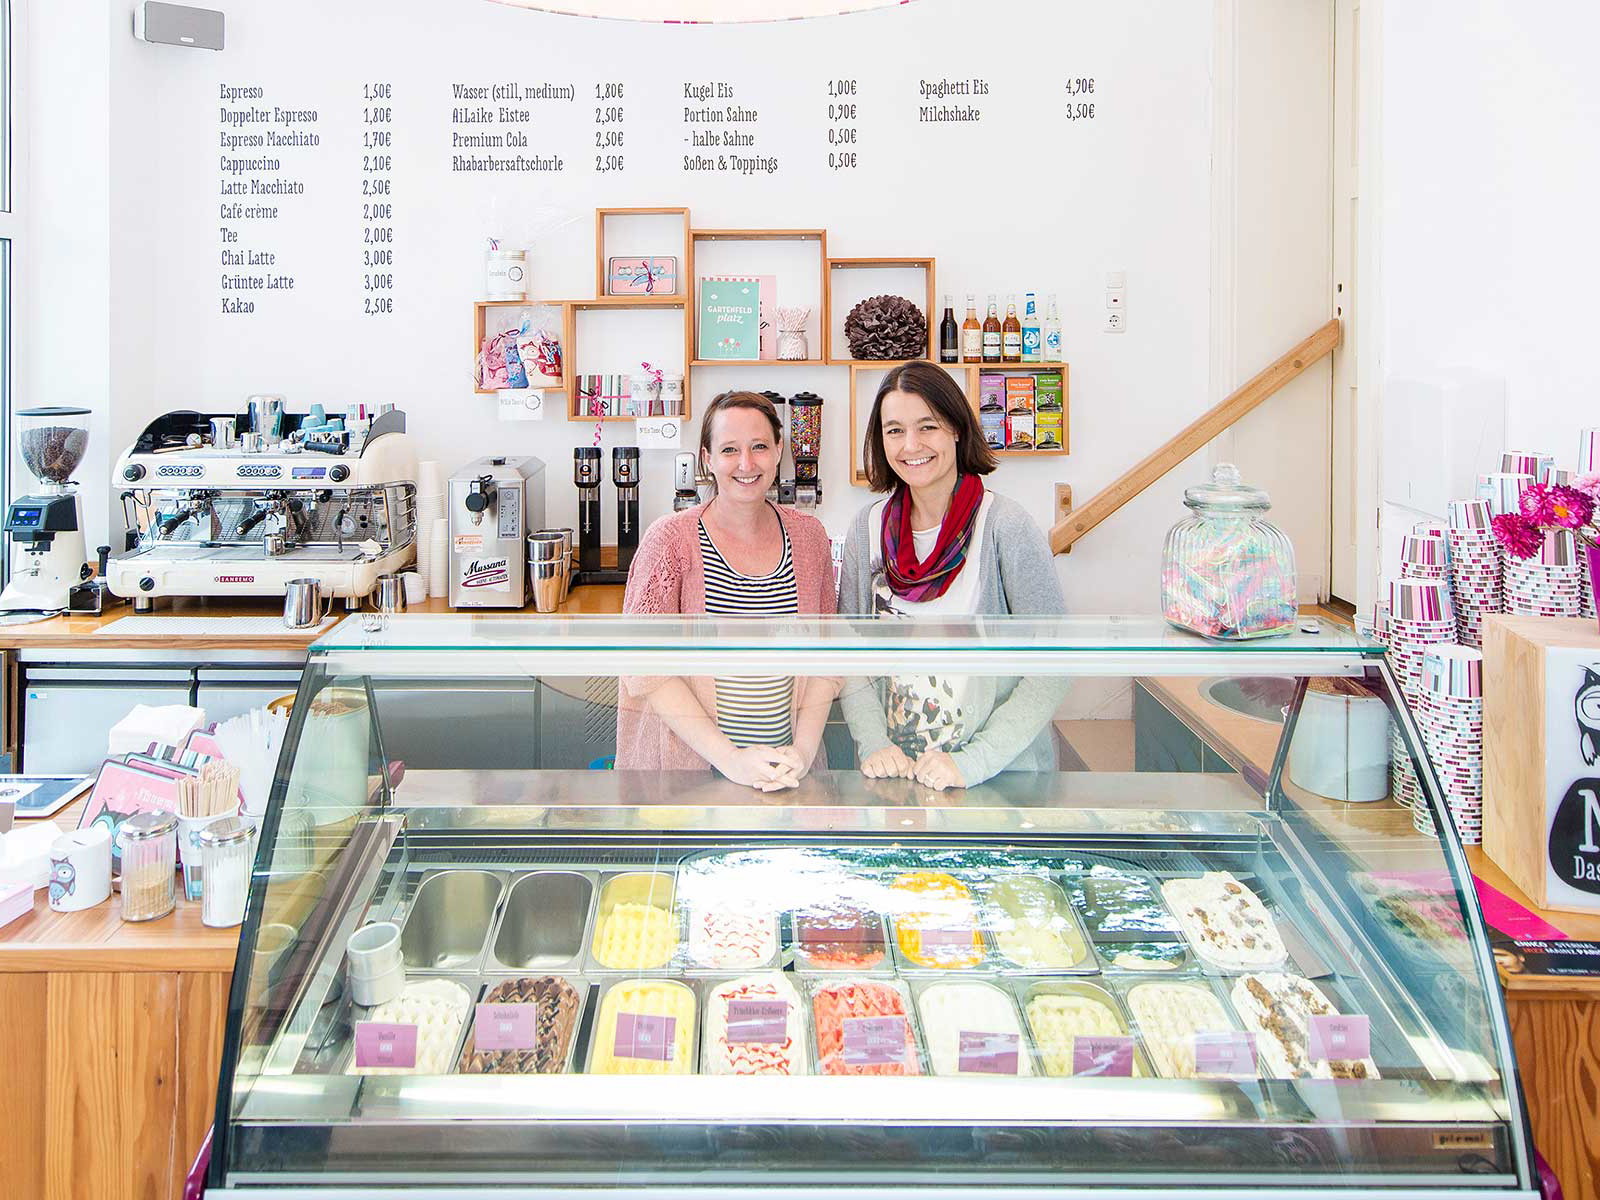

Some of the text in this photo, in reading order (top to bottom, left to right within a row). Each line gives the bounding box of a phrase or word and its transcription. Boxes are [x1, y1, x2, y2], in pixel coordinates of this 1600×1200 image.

[220, 84, 391, 103] Espresso 1,50€
[452, 83, 623, 102] Wasser (still, medium) 1,80€
[684, 80, 856, 102] Kugel Eis 1,00€
[920, 78, 1094, 99] Spaghetti Eis 4,90€
[221, 107, 391, 127] Doppelter Espresso 1,80€
[499, 107, 529, 122] Eistee
[596, 107, 623, 125] 2,50€
[684, 104, 856, 122] Portion Sahne 0,90€
[920, 104, 1095, 122] Milchshake 3,50€
[220, 130, 391, 151] Espresso Macchiato 1,70€
[453, 131, 623, 149] Premium Cola 2,50€
[692, 130, 720, 146] halbe
[723, 130, 754, 146] Sahne
[829, 129, 856, 146] 0,50€
[221, 156, 391, 175] Cappuccino 2,10€
[453, 155, 624, 173] Rhabarbersaftschorle 2,50€
[718, 155, 727, 170] &
[730, 155, 778, 175] Toppings
[829, 153, 856, 170] 0,50€
[221, 179, 390, 197] Latte Macchiato 2,50€
[221, 203, 391, 221] Café crème 2,00€
[220, 228, 392, 245] Tee 2,00€
[222, 250, 392, 268] Chai Latte 3,00€
[222, 274, 392, 292] Grüntee Latte 3,00€
[222, 298, 392, 316] Kakao 2,50€
[707, 305, 753, 314] GARTENFELD
[716, 313, 744, 325] platz
[464, 560, 507, 576] Mussana
